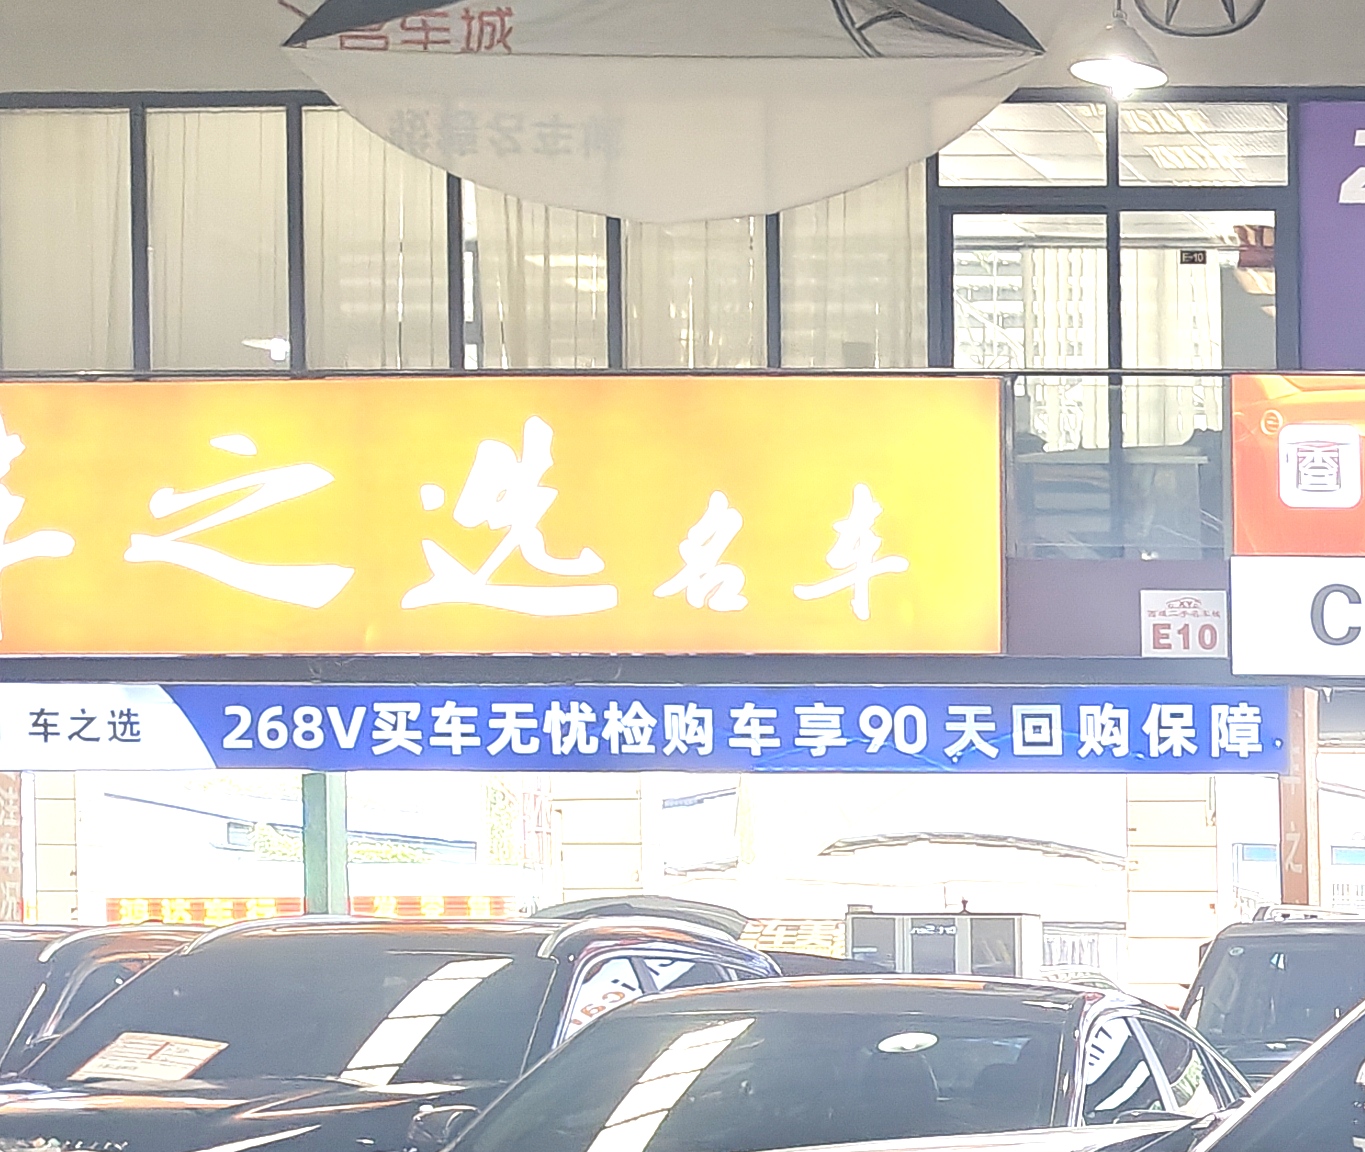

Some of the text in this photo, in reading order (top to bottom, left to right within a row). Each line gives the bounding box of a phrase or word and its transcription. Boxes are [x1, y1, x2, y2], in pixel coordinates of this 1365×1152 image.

[1152, 623, 1217, 650] E10
[28, 708, 141, 743] 车之选
